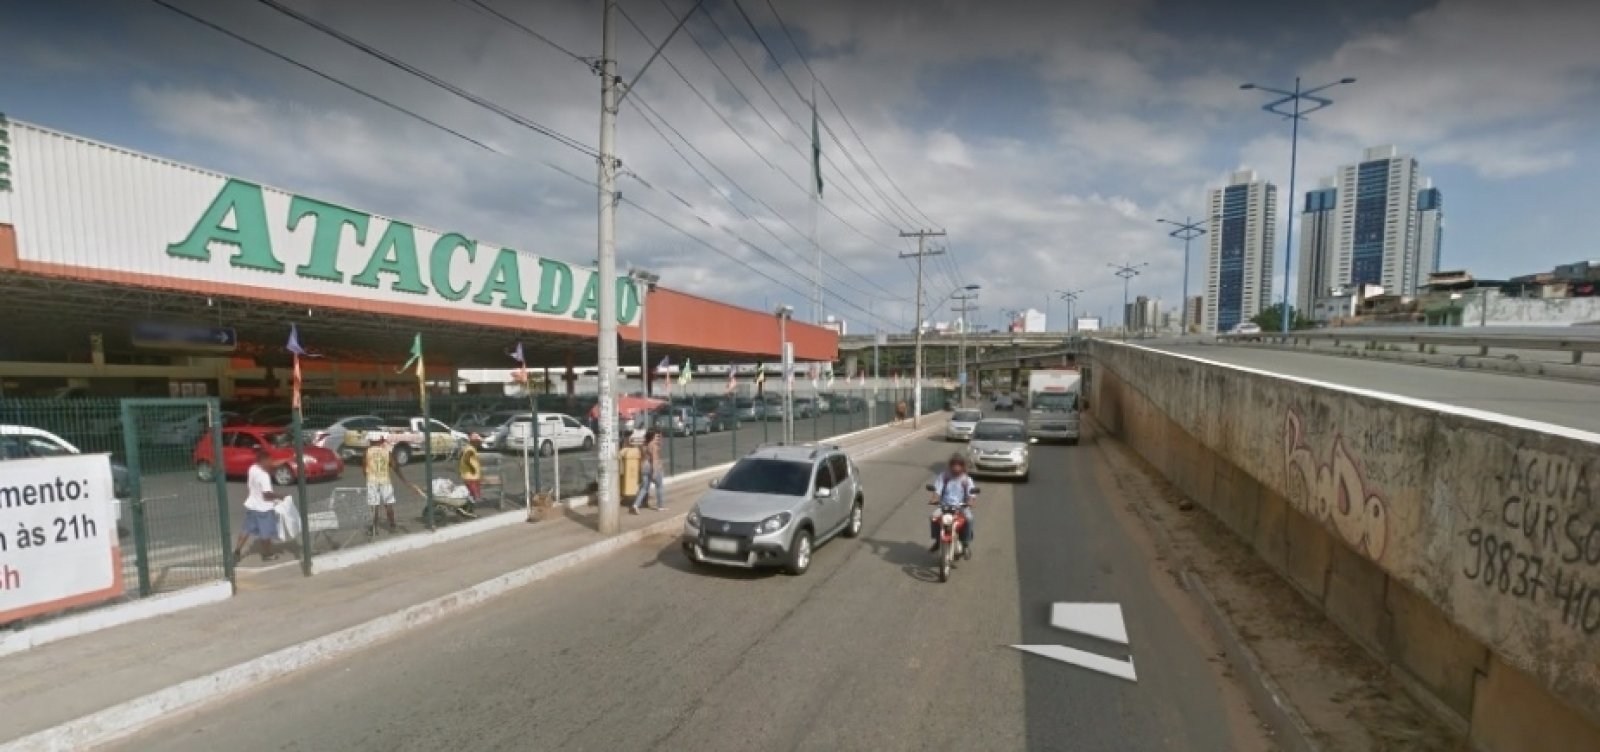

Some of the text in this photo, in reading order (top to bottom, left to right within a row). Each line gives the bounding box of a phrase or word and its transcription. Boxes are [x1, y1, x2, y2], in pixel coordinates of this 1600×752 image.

[17, 523, 46, 549] às
[53, 514, 97, 543] 21h
[0, 564, 20, 590] h
[1463, 528, 1544, 600] 98837
